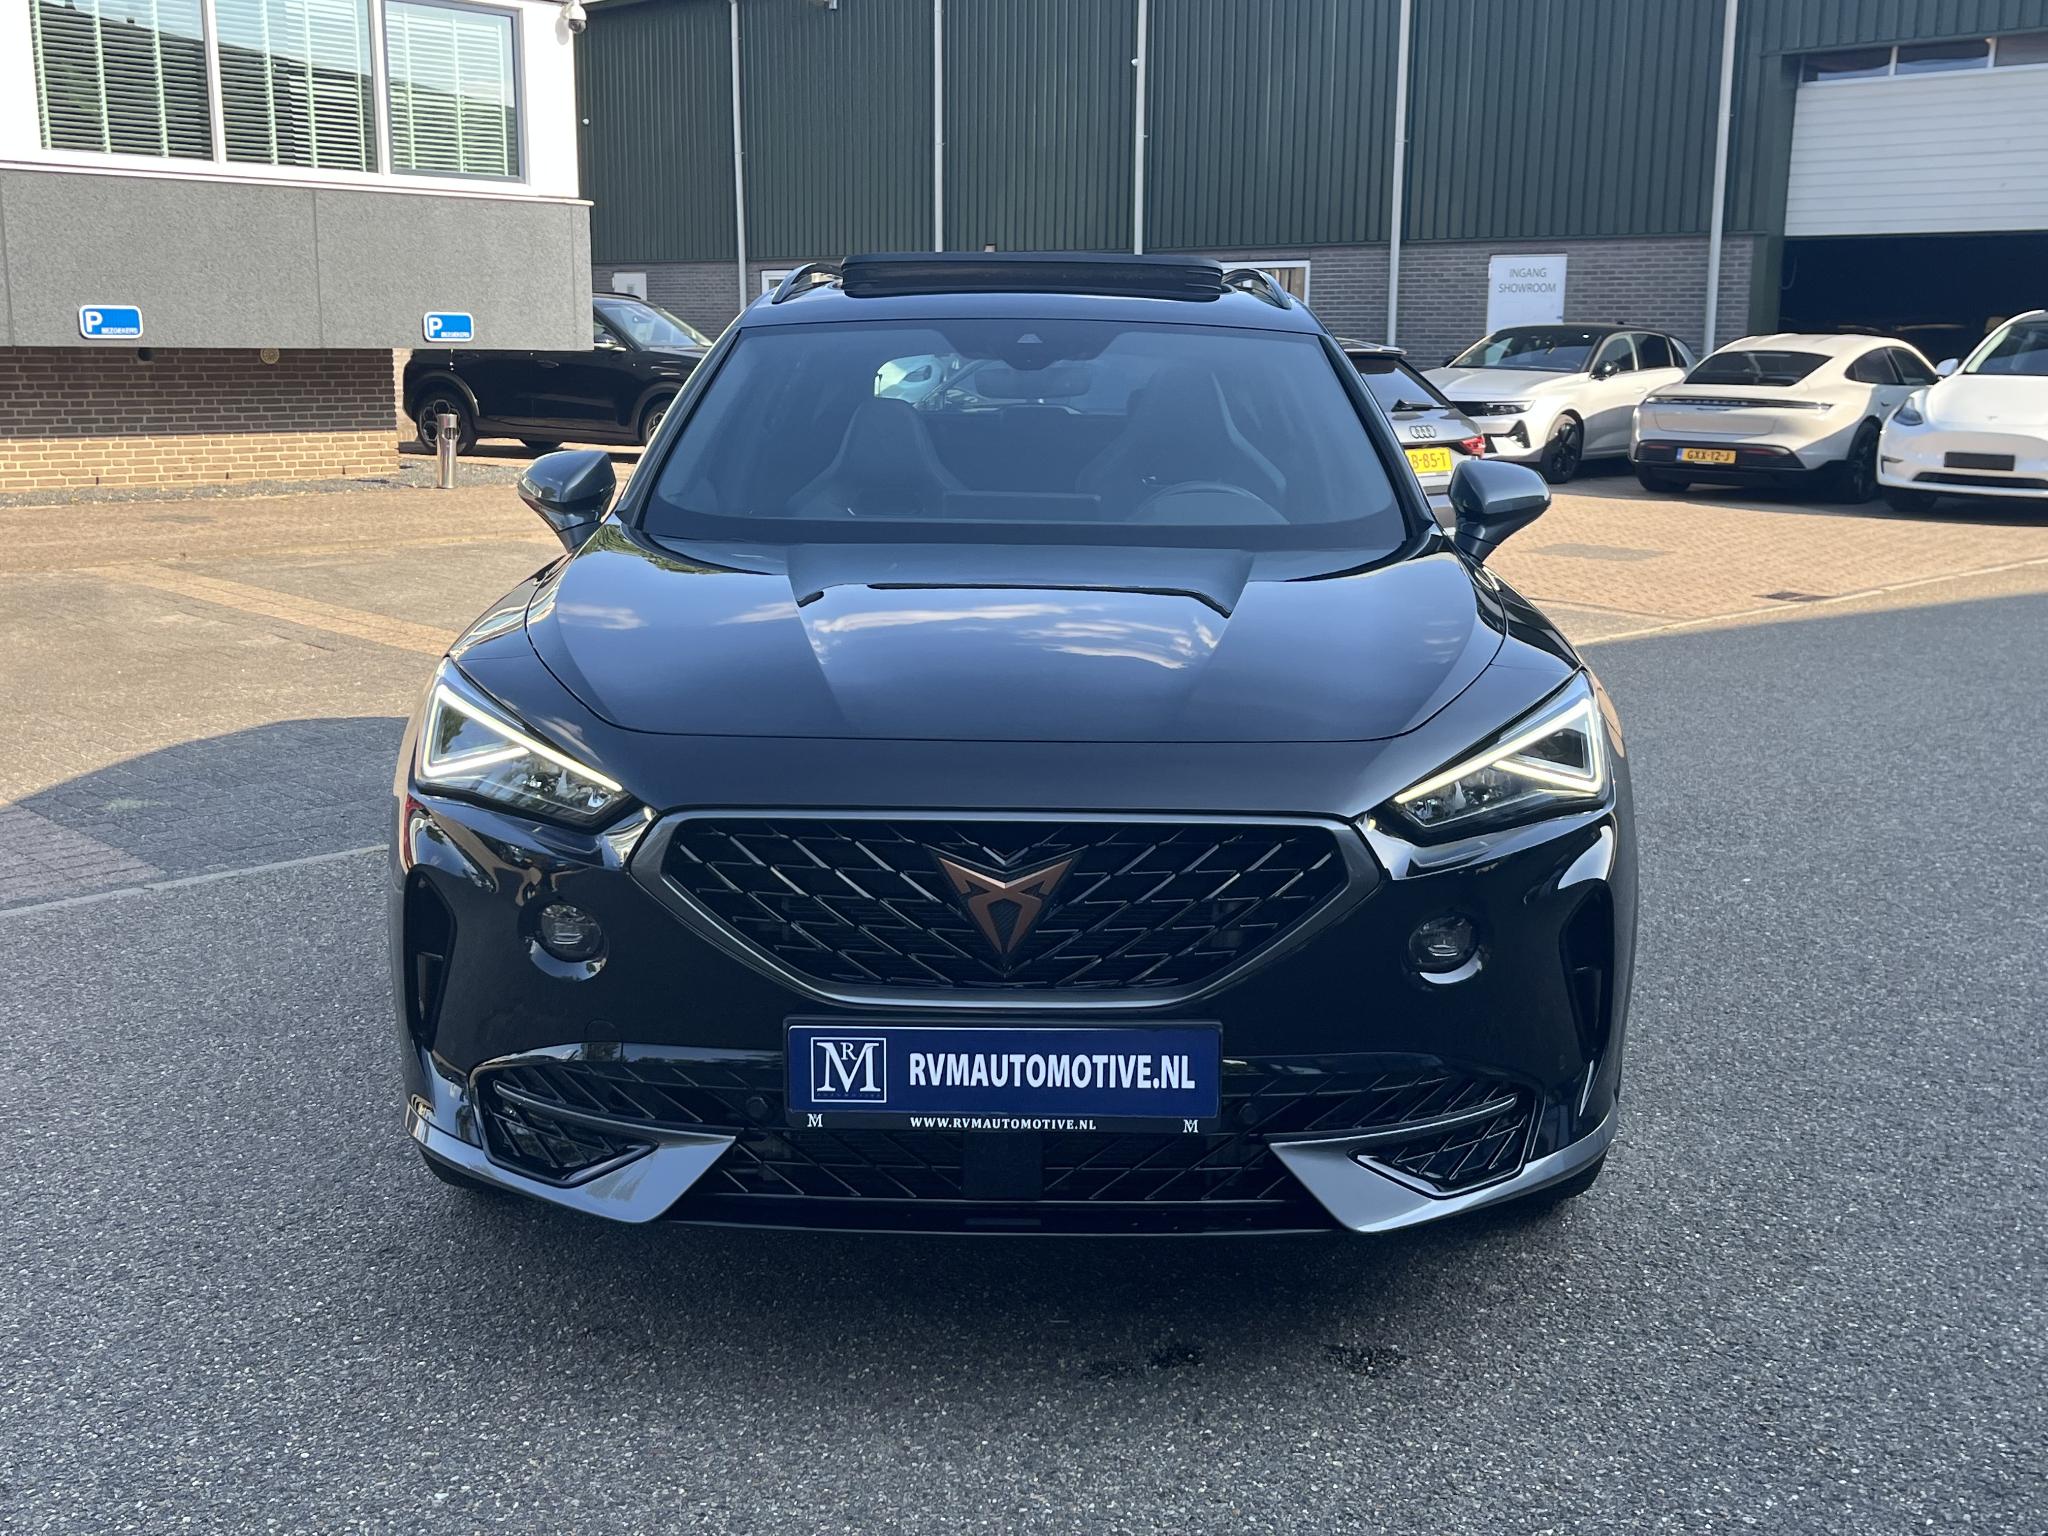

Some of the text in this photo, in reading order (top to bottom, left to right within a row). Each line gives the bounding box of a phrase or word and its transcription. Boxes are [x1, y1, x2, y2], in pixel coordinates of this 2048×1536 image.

[1509, 267, 1547, 278] INGANG
[1498, 283, 1556, 293] SHOWROOM
[85, 311, 103, 332] P
[428, 317, 443, 337] P
[909, 1053, 1196, 1089] RVMAUTOMOTIVE.NL
[910, 1116, 1097, 1130] WWW.RVMAUTOMOTIVE.NL
